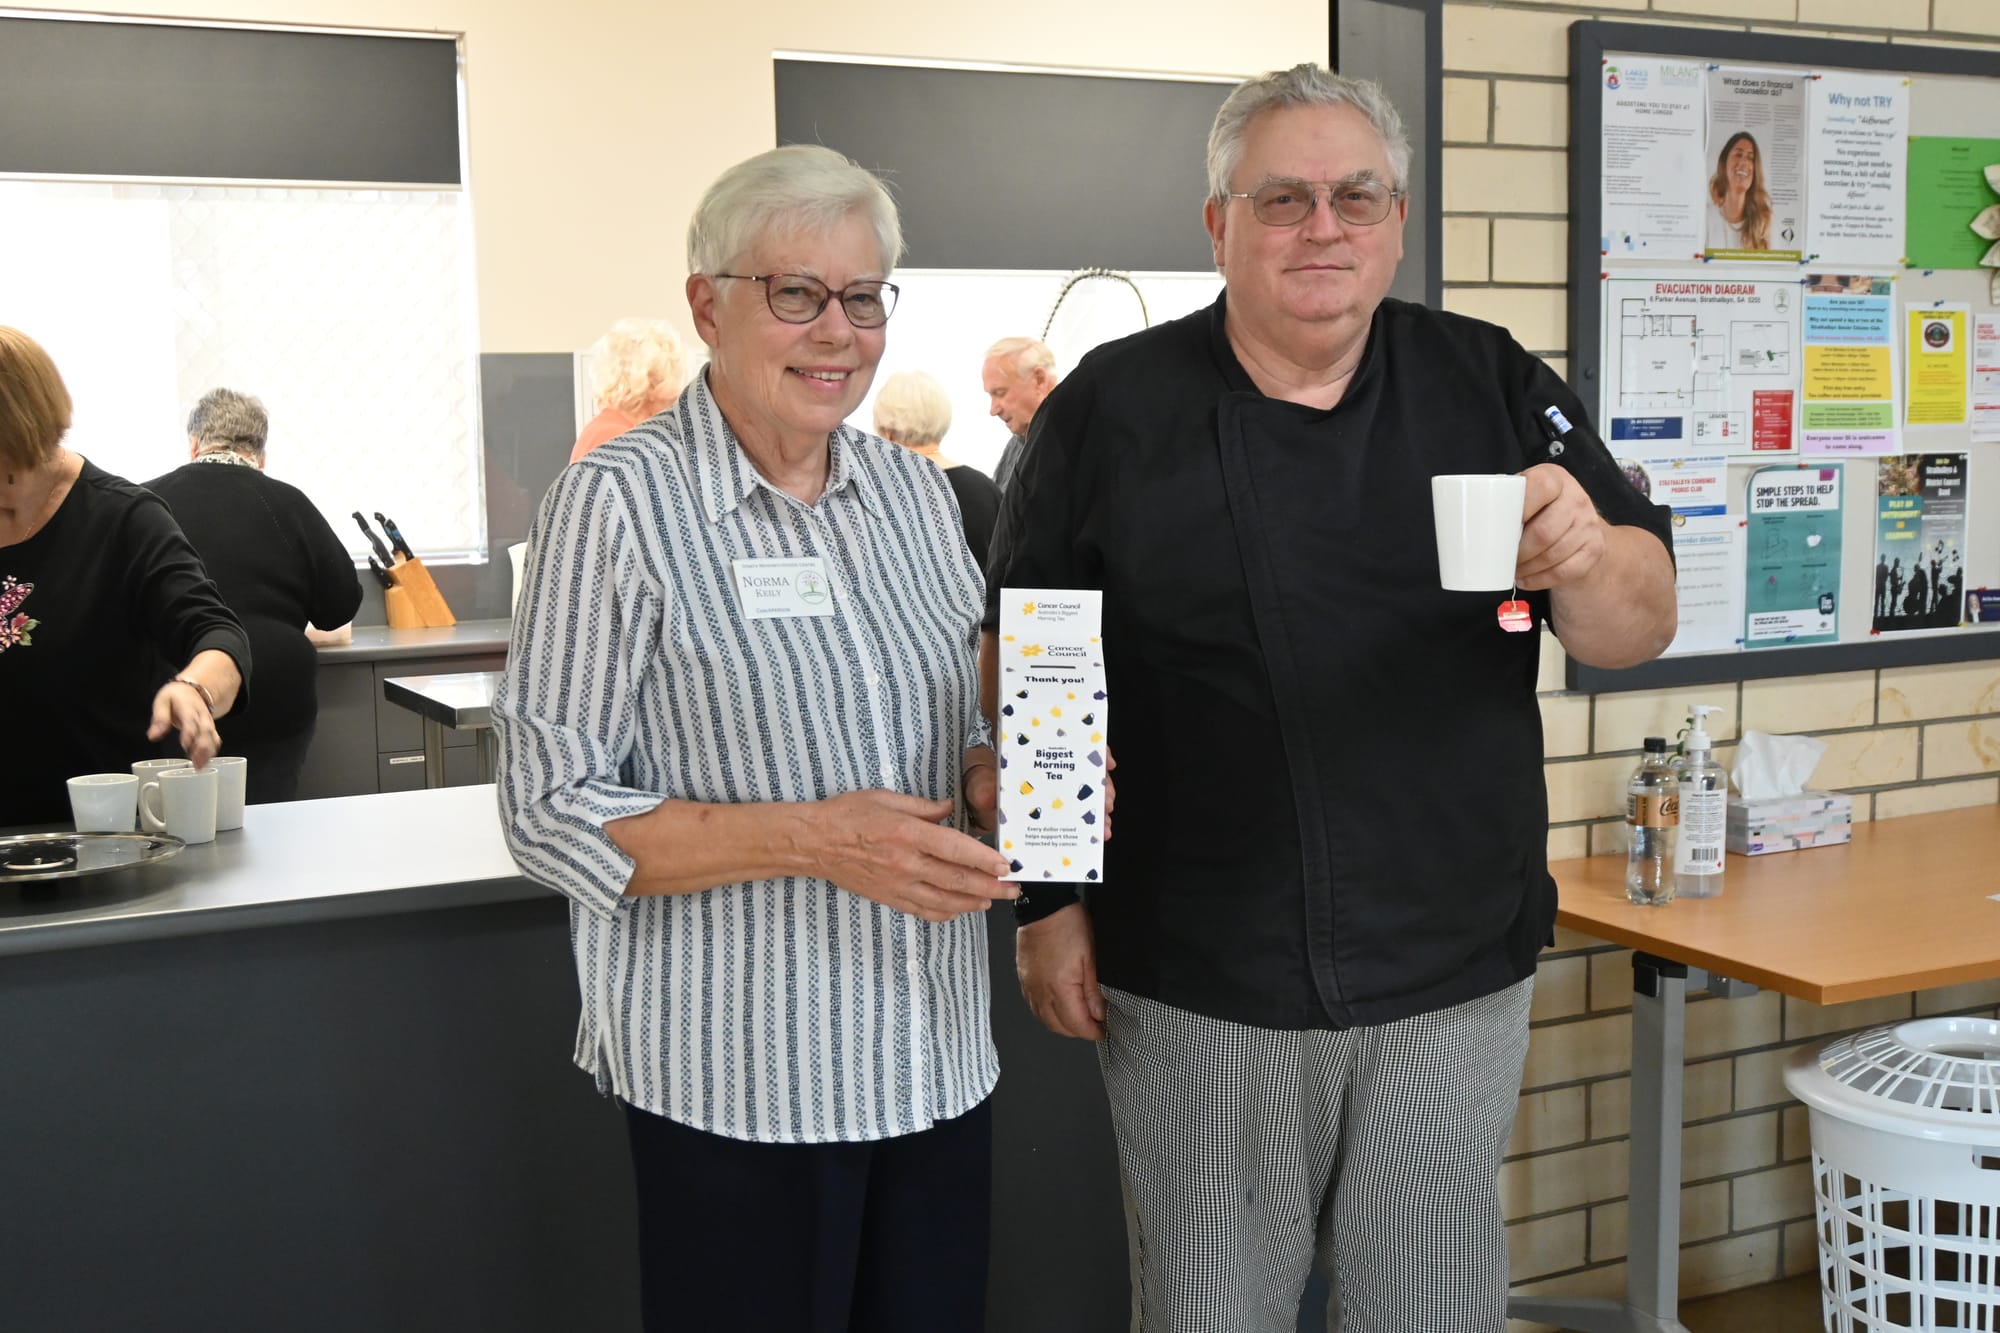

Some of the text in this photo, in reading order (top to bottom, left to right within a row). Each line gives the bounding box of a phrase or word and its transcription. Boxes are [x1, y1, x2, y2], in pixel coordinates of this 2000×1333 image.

[1723, 77, 1740, 86] What
[1742, 78, 1760, 87] does
[1766, 79, 1794, 90] financial
[1734, 87, 1783, 97] counsellor do?
[1828, 92, 1893, 108] Why not TRY
[1824, 168, 1841, 176] have
[1655, 283, 1756, 296] EVACUATION DIAGRAM
[1655, 295, 1675, 303] Parker
[1675, 296, 1699, 304] Avenue,
[1754, 398, 1761, 406] R
[1754, 409, 1761, 417] A
[1754, 430, 1761, 438] C
[1806, 434, 1832, 444] Everyone
[1754, 441, 1761, 449] E
[1690, 485, 1703, 493] CLUB
[1756, 484, 1834, 497] SIMPLE STEPS TO HELP
[1756, 496, 1821, 508] STOP THE SPREAD.
[1024, 675, 1085, 685] Thank you!
[1035, 749, 1074, 760] Biggest
[1033, 760, 1076, 772] Morning
[1046, 772, 1063, 780] Tea
